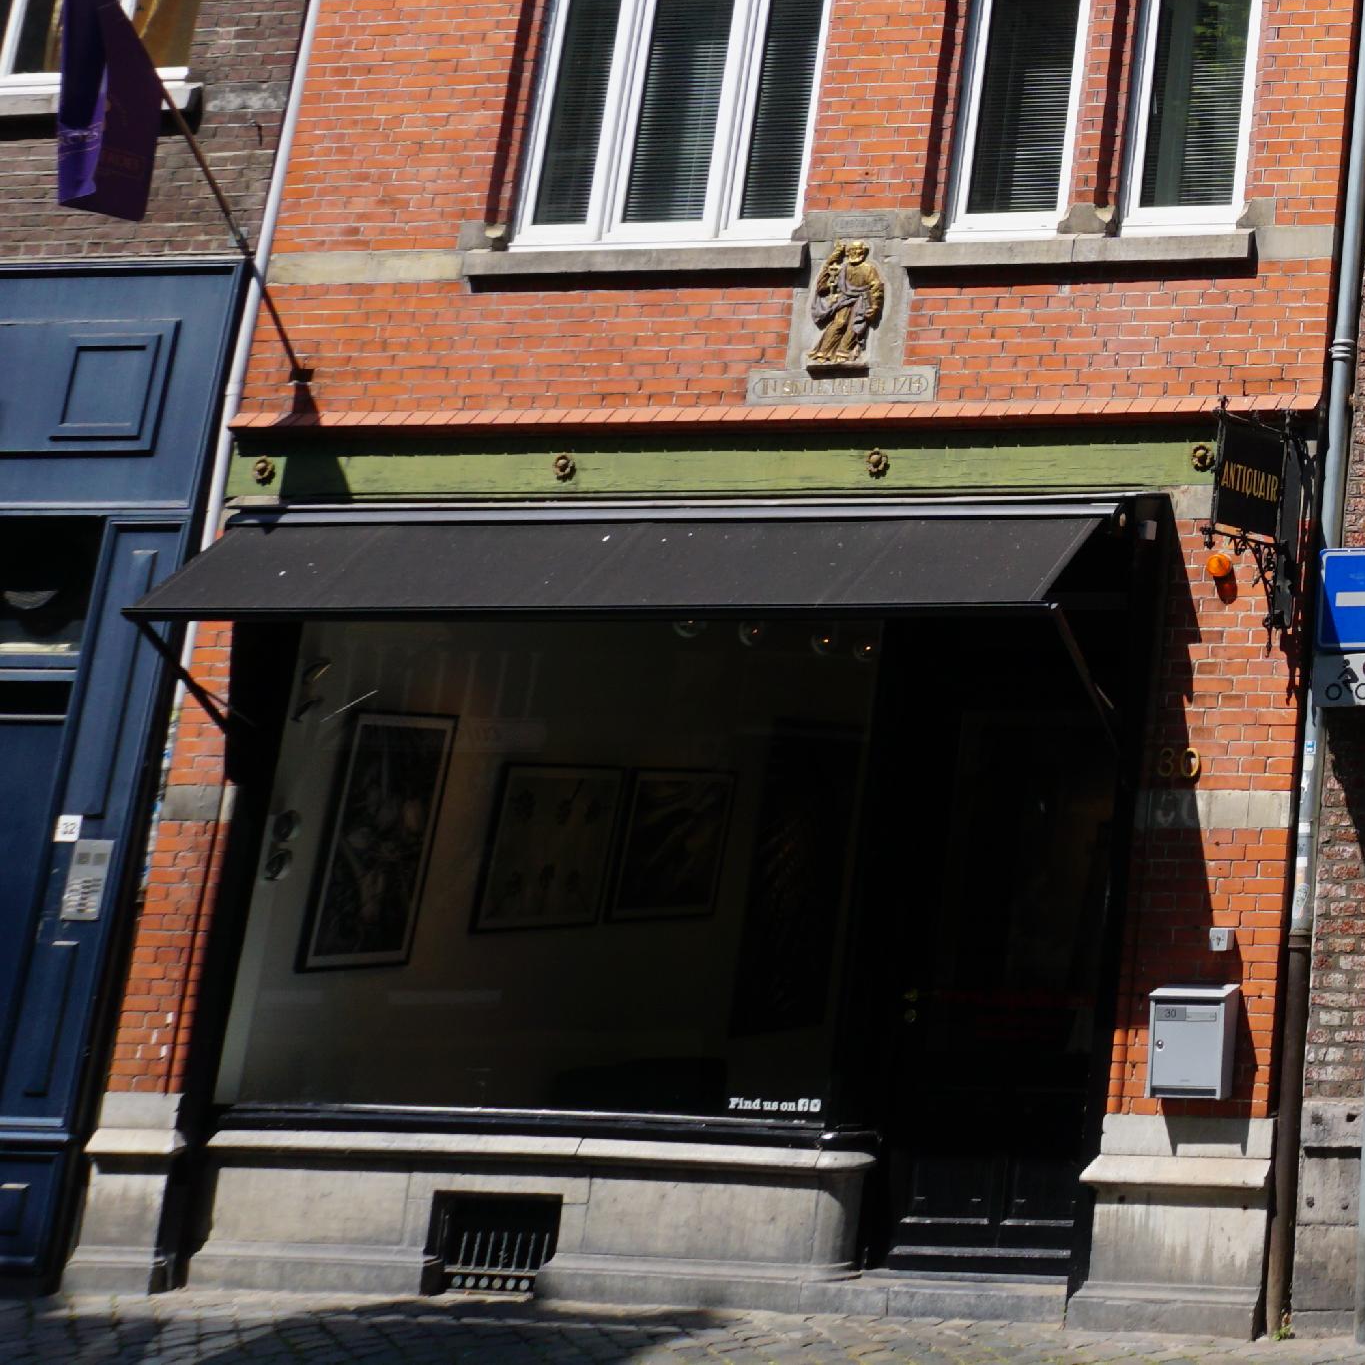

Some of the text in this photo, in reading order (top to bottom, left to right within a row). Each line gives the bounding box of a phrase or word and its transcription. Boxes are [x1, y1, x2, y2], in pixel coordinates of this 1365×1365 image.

[1221, 460, 1279, 502] ANTIQUAIR
[1158, 747, 1200, 778] 30
[1163, 1008, 1177, 1019] 30
[728, 1097, 796, 1112] Find us on
